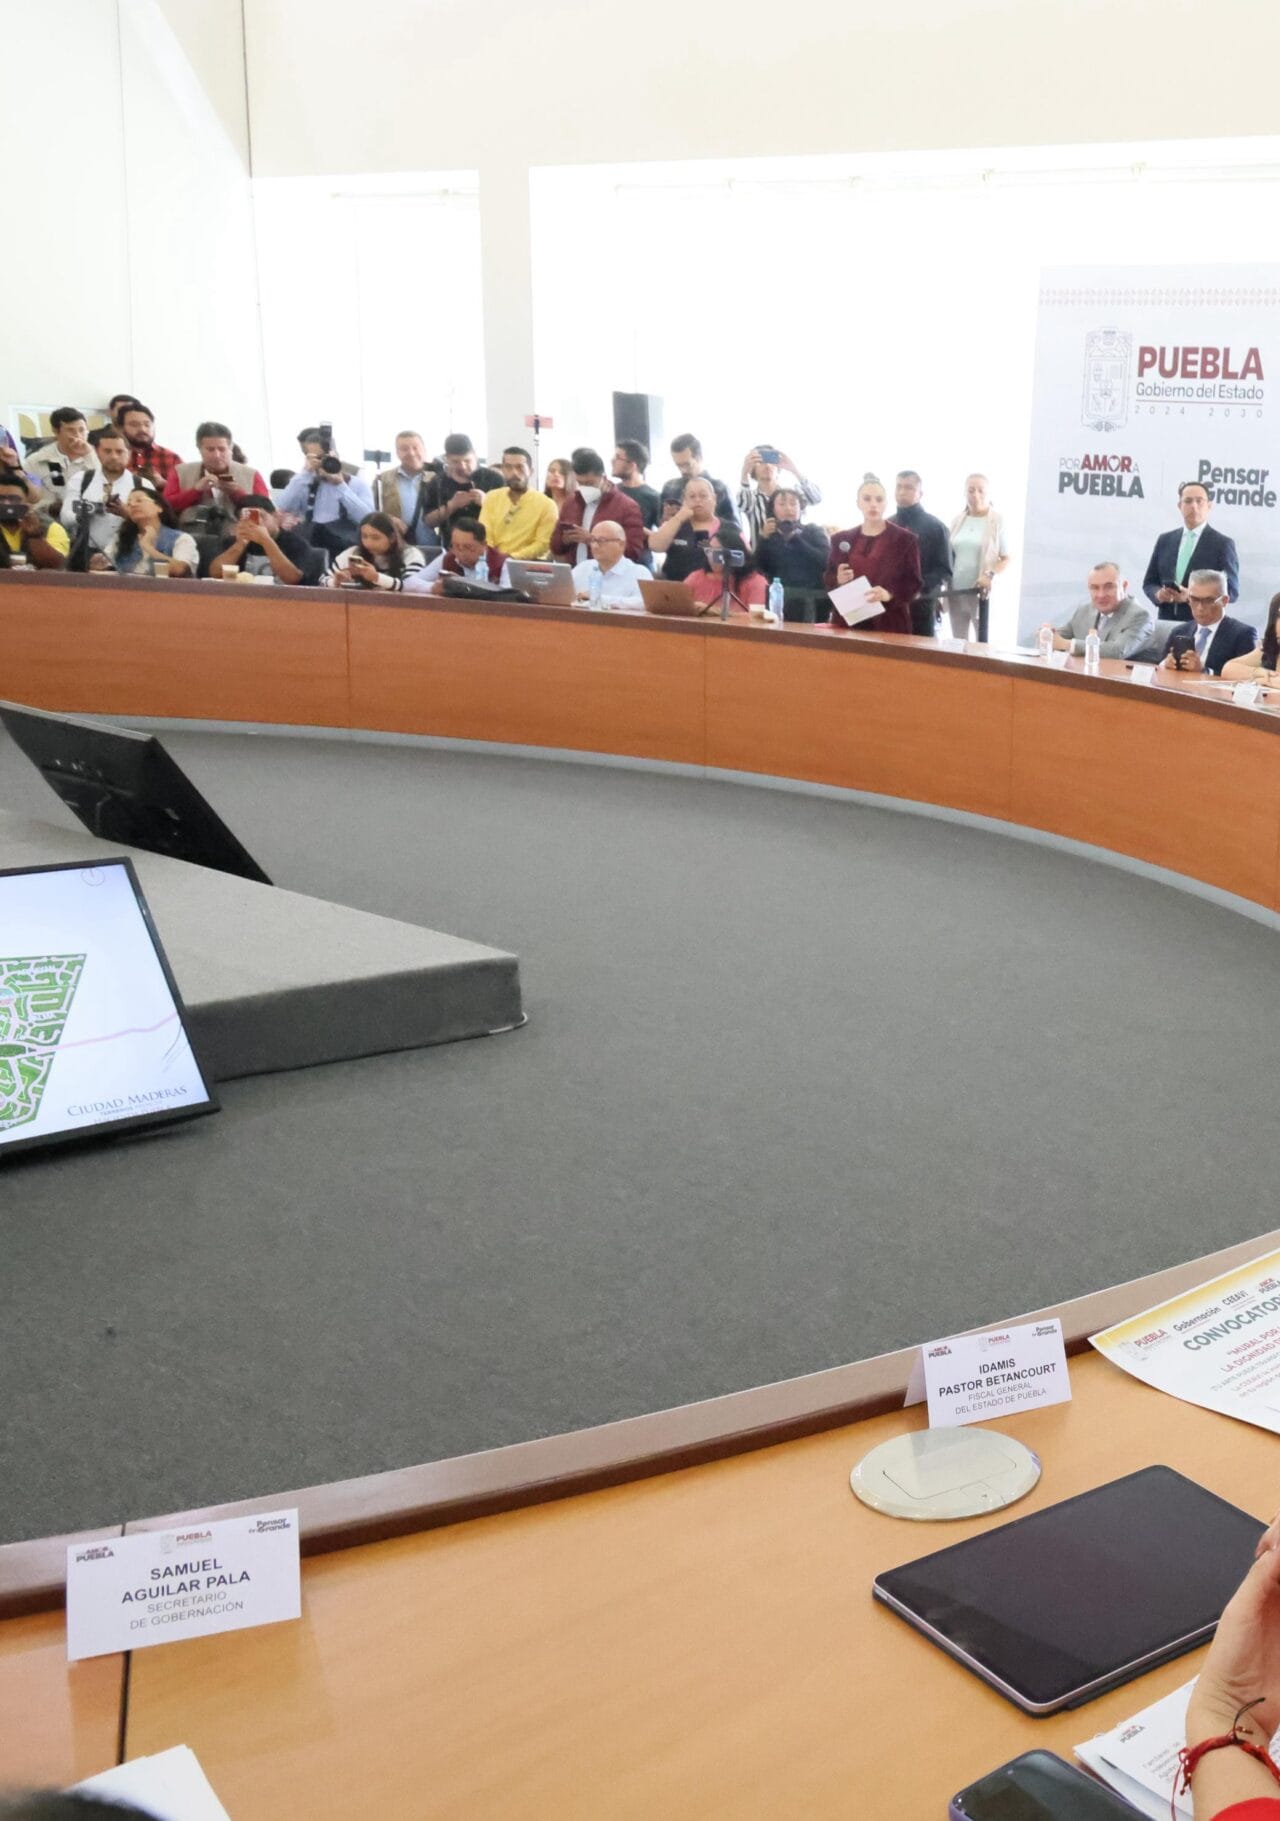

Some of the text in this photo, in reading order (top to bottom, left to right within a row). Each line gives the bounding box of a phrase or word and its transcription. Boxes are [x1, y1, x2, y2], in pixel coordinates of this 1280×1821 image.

[1137, 346, 1264, 380] PUEBLA
[1136, 382, 1264, 400] Gobierno del Estado
[1198, 459, 1269, 485] Pensar
[1058, 472, 1145, 499] PUEBLA
[67, 1097, 124, 1116] CIUDAD
[128, 1085, 188, 1105] MADERAS
[1133, 1328, 1168, 1348] PUEBLA
[1172, 1306, 1223, 1332] Gobernación
[1261, 1327, 1280, 1341] POR
[978, 1358, 1016, 1374] IDAMIS
[1220, 1362, 1235, 1373] LA
[1232, 1342, 1277, 1367] DIGNIDAD
[938, 1363, 1057, 1397] PASTOR BETANCOURT
[968, 1381, 1033, 1401] FISCAL GENERAL
[955, 1388, 1047, 1415] DEL ESTADO DE PUEBLA
[176, 1530, 212, 1543] PUEBLA
[76, 1550, 115, 1563] PUEBLA
[150, 1558, 223, 1581] SAMUEL
[121, 1570, 251, 1604] AGUILAR PALA
[147, 1590, 227, 1614] SECRETARIO
[130, 1601, 244, 1631] DE GOBERNACIÓN
